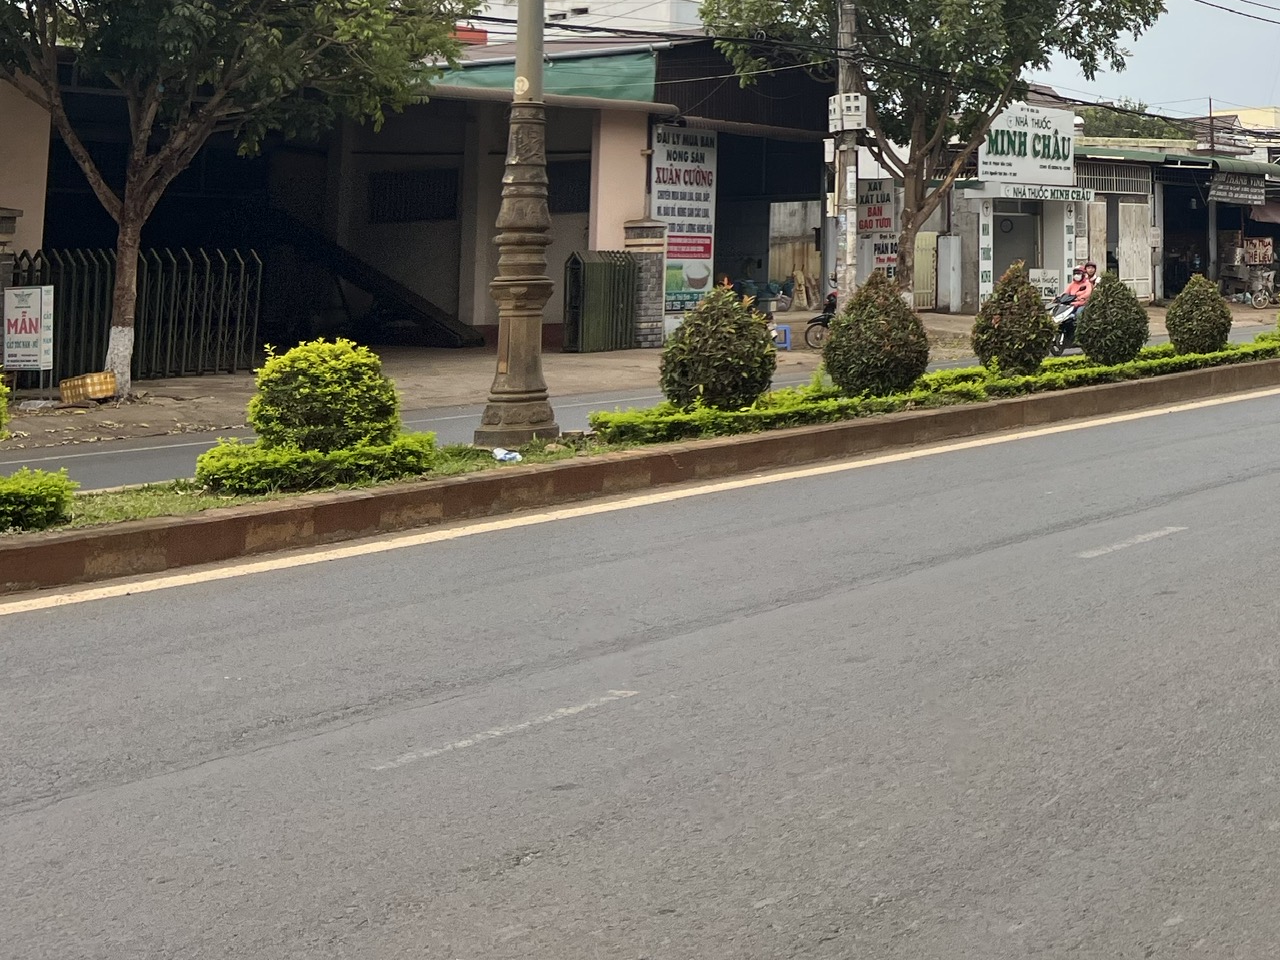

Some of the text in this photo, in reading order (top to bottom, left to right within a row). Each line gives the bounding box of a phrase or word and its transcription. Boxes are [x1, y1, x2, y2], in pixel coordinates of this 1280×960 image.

[1014, 115, 1052, 129] NHÀ THUỐC
[986, 128, 1071, 161] MINH CHÂU
[655, 163, 713, 187] XUÂN CƯỜNG
[868, 181, 883, 191] XAY
[1013, 186, 1091, 200] NHÀ THUỐC MINH CHÂU
